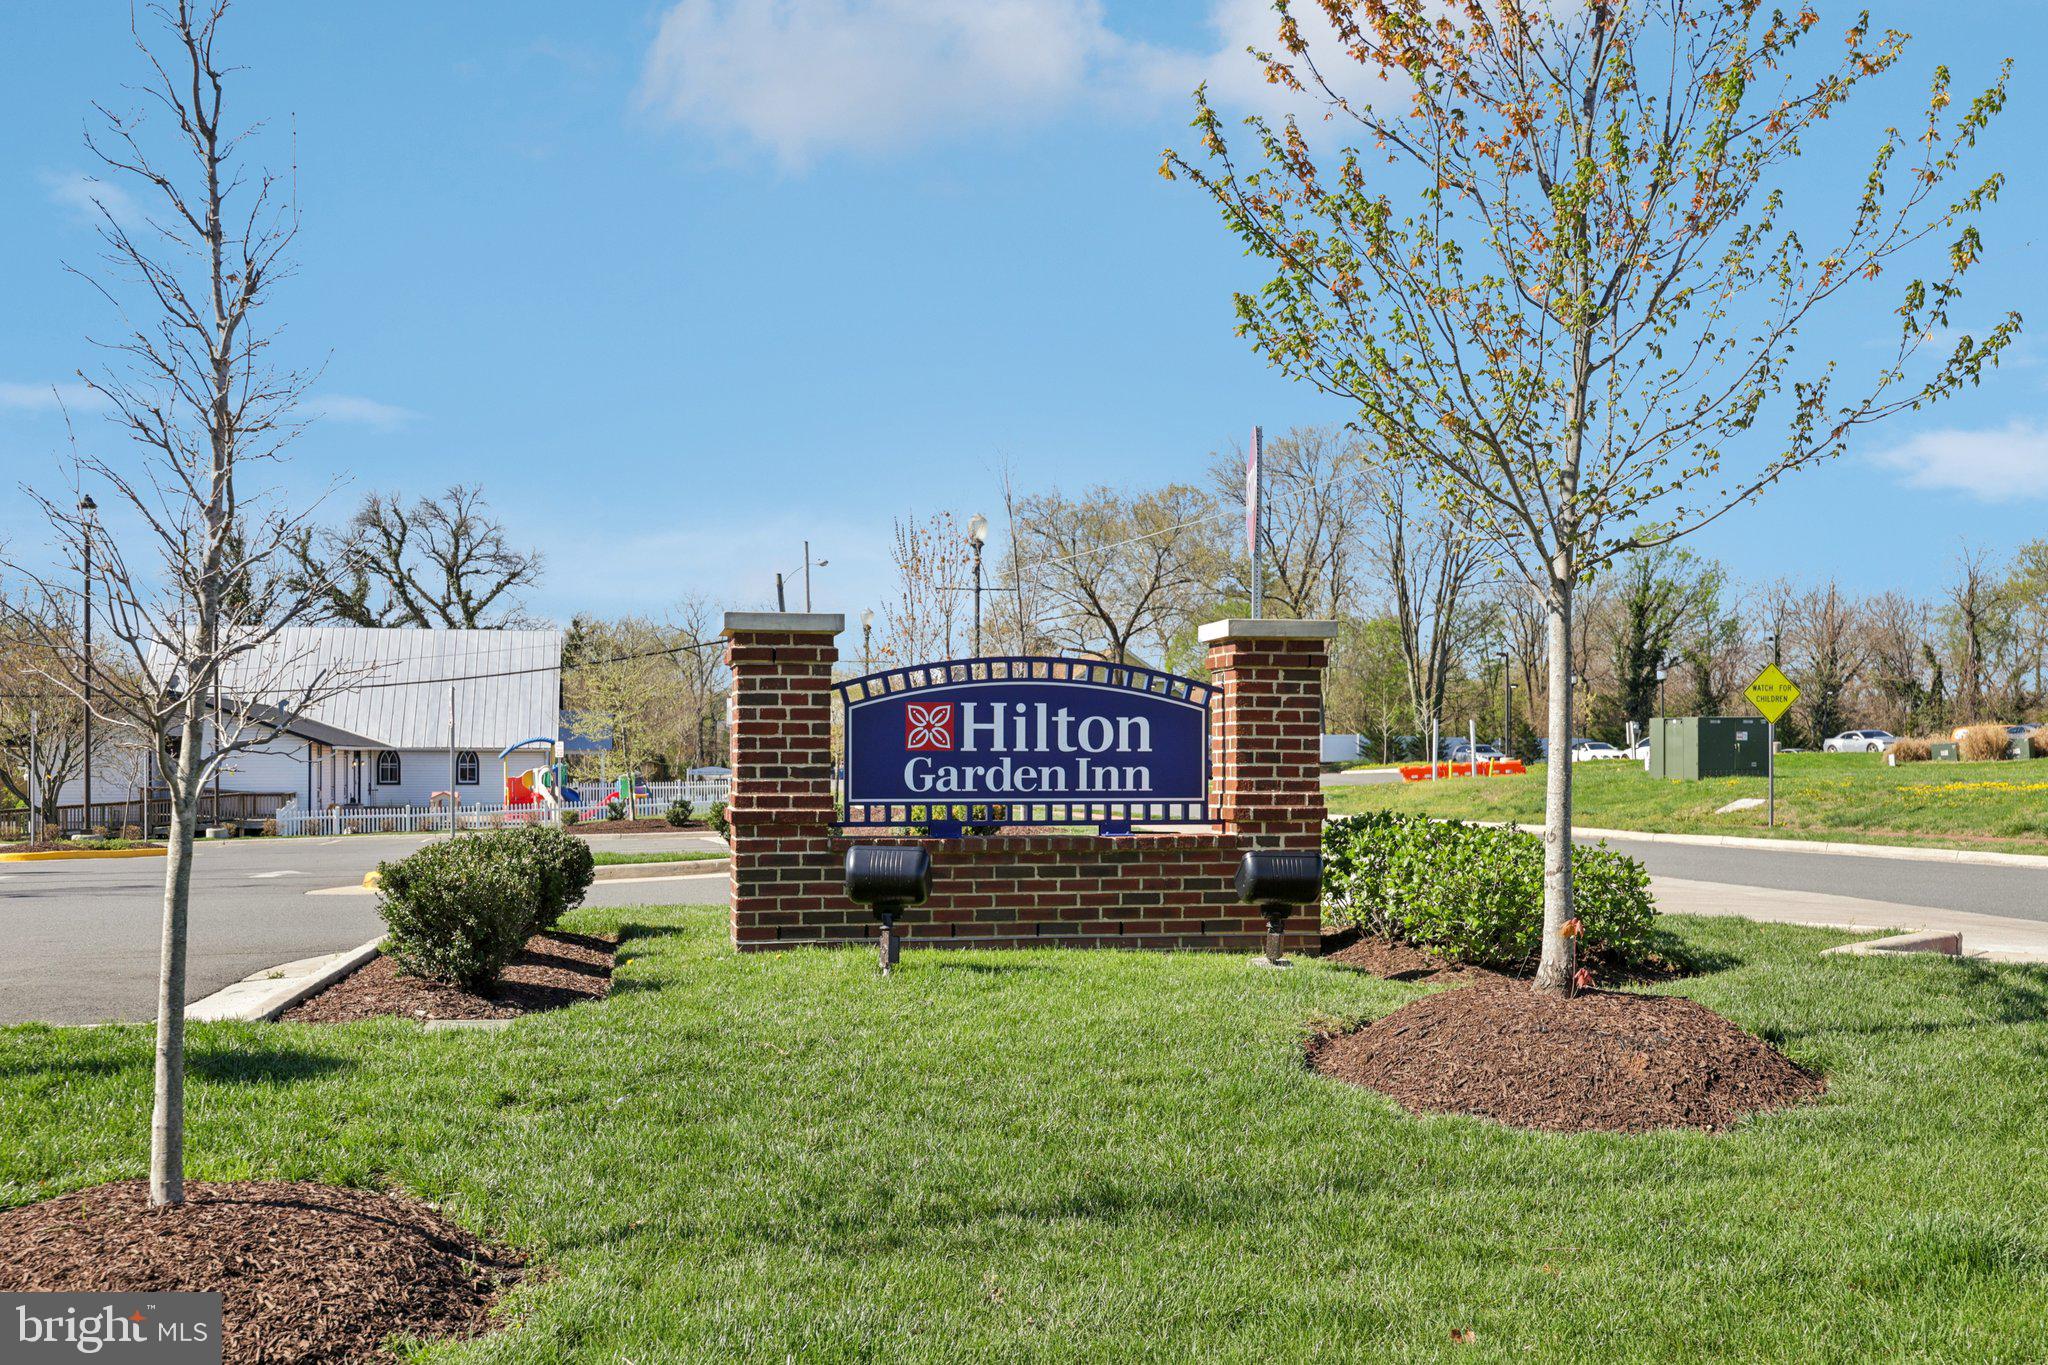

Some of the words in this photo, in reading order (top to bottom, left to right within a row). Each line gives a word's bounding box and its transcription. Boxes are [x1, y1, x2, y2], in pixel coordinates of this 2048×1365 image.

[1752, 684, 1774, 692] WATCH
[1779, 684, 1792, 692] FOR
[1756, 695, 1788, 703] CHILDREN
[960, 702, 1153, 753] Hilton
[904, 757, 1069, 792] Garden
[1075, 758, 1153, 792] Inn
